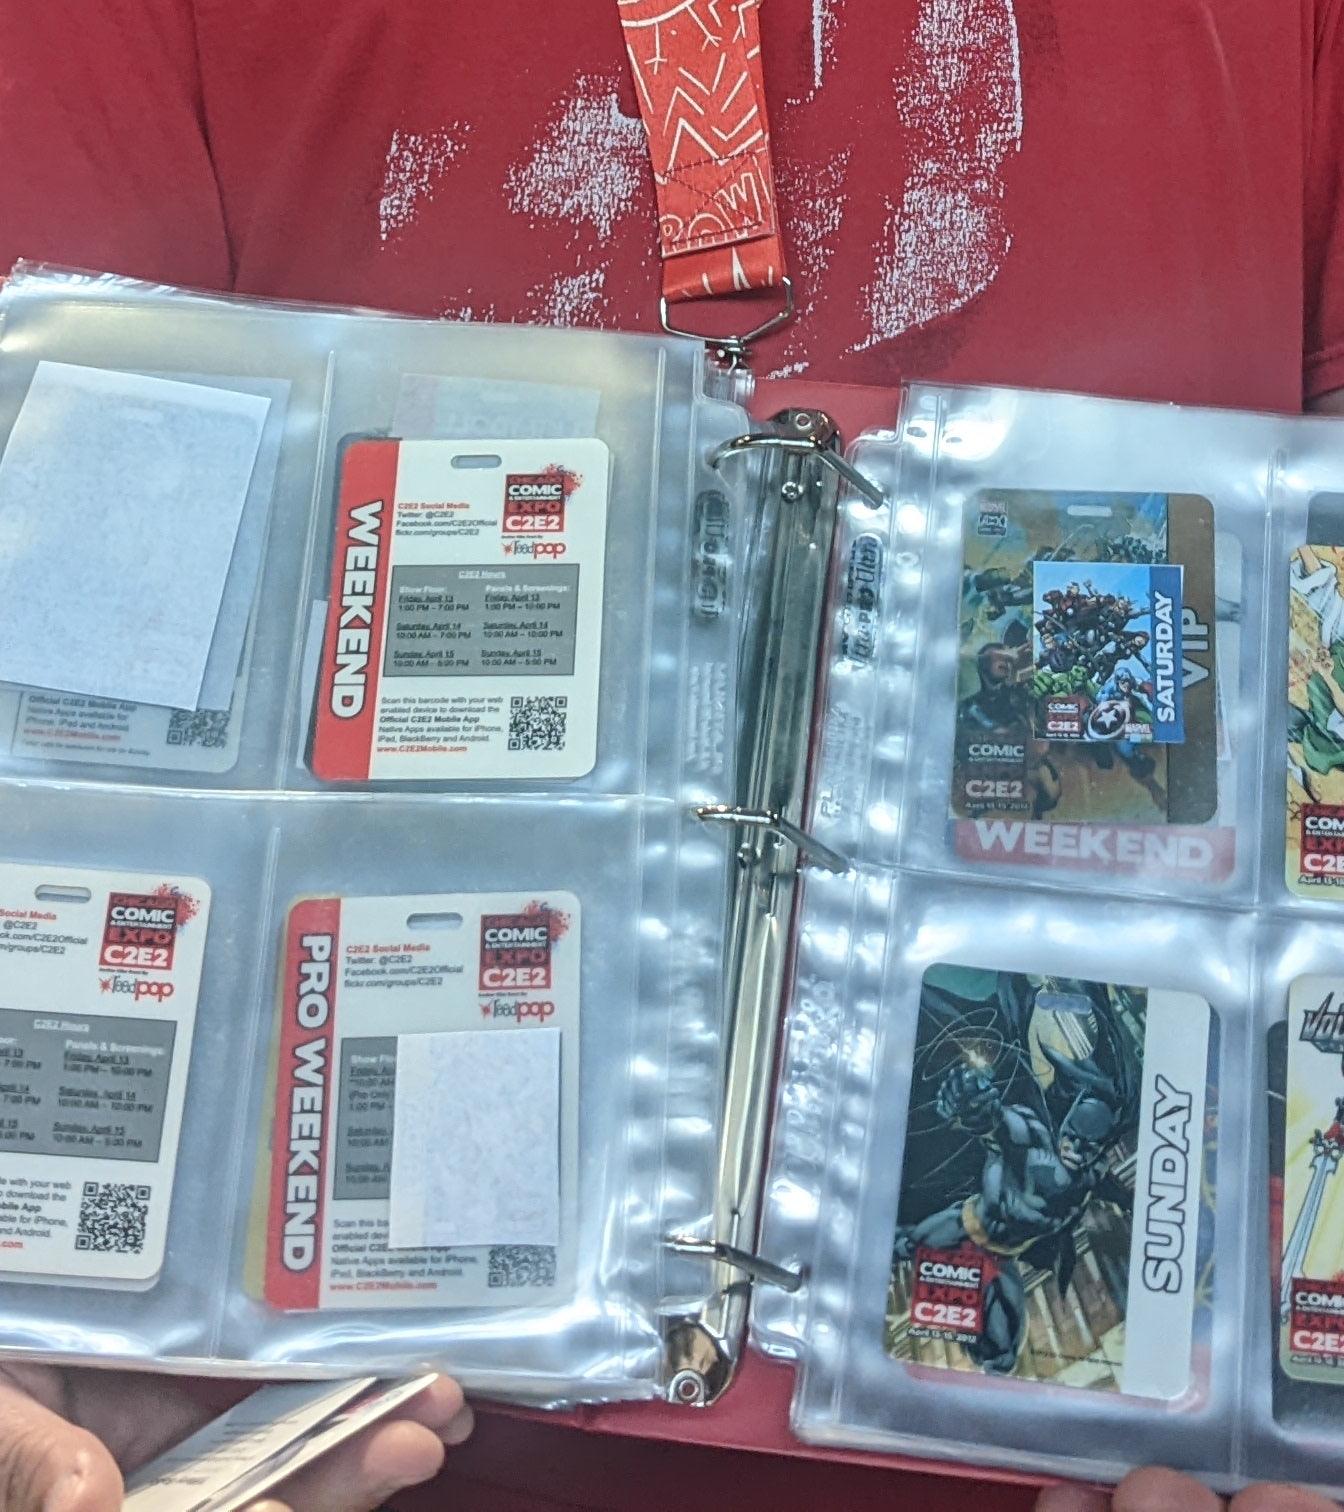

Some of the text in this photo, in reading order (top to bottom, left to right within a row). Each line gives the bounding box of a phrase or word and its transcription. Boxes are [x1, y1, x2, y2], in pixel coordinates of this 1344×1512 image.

[508, 484, 563, 495] COMIC
[506, 515, 560, 530] C2E2
[329, 498, 385, 720] WEEKEND
[1156, 590, 1175, 723] SATURDAY
[1182, 606, 1211, 689] VIP
[1047, 721, 1079, 732] C2E2
[968, 743, 1026, 758] COMIC
[965, 778, 1024, 799] C2E2
[974, 821, 1214, 870] WEEKEND
[3, 920, 38, 930] @C2E2
[29, 911, 57, 920] Media
[111, 906, 175, 923] COMIC
[484, 927, 548, 943] COMIC
[104, 945, 169, 966] C2E2
[482, 967, 546, 987] C2E2
[282, 932, 332, 1273] PRO WEEKEND
[1142, 1073, 1193, 1294] SUNDAY
[919, 1261, 981, 1282] COMIC
[914, 1302, 977, 1328] C2E2
